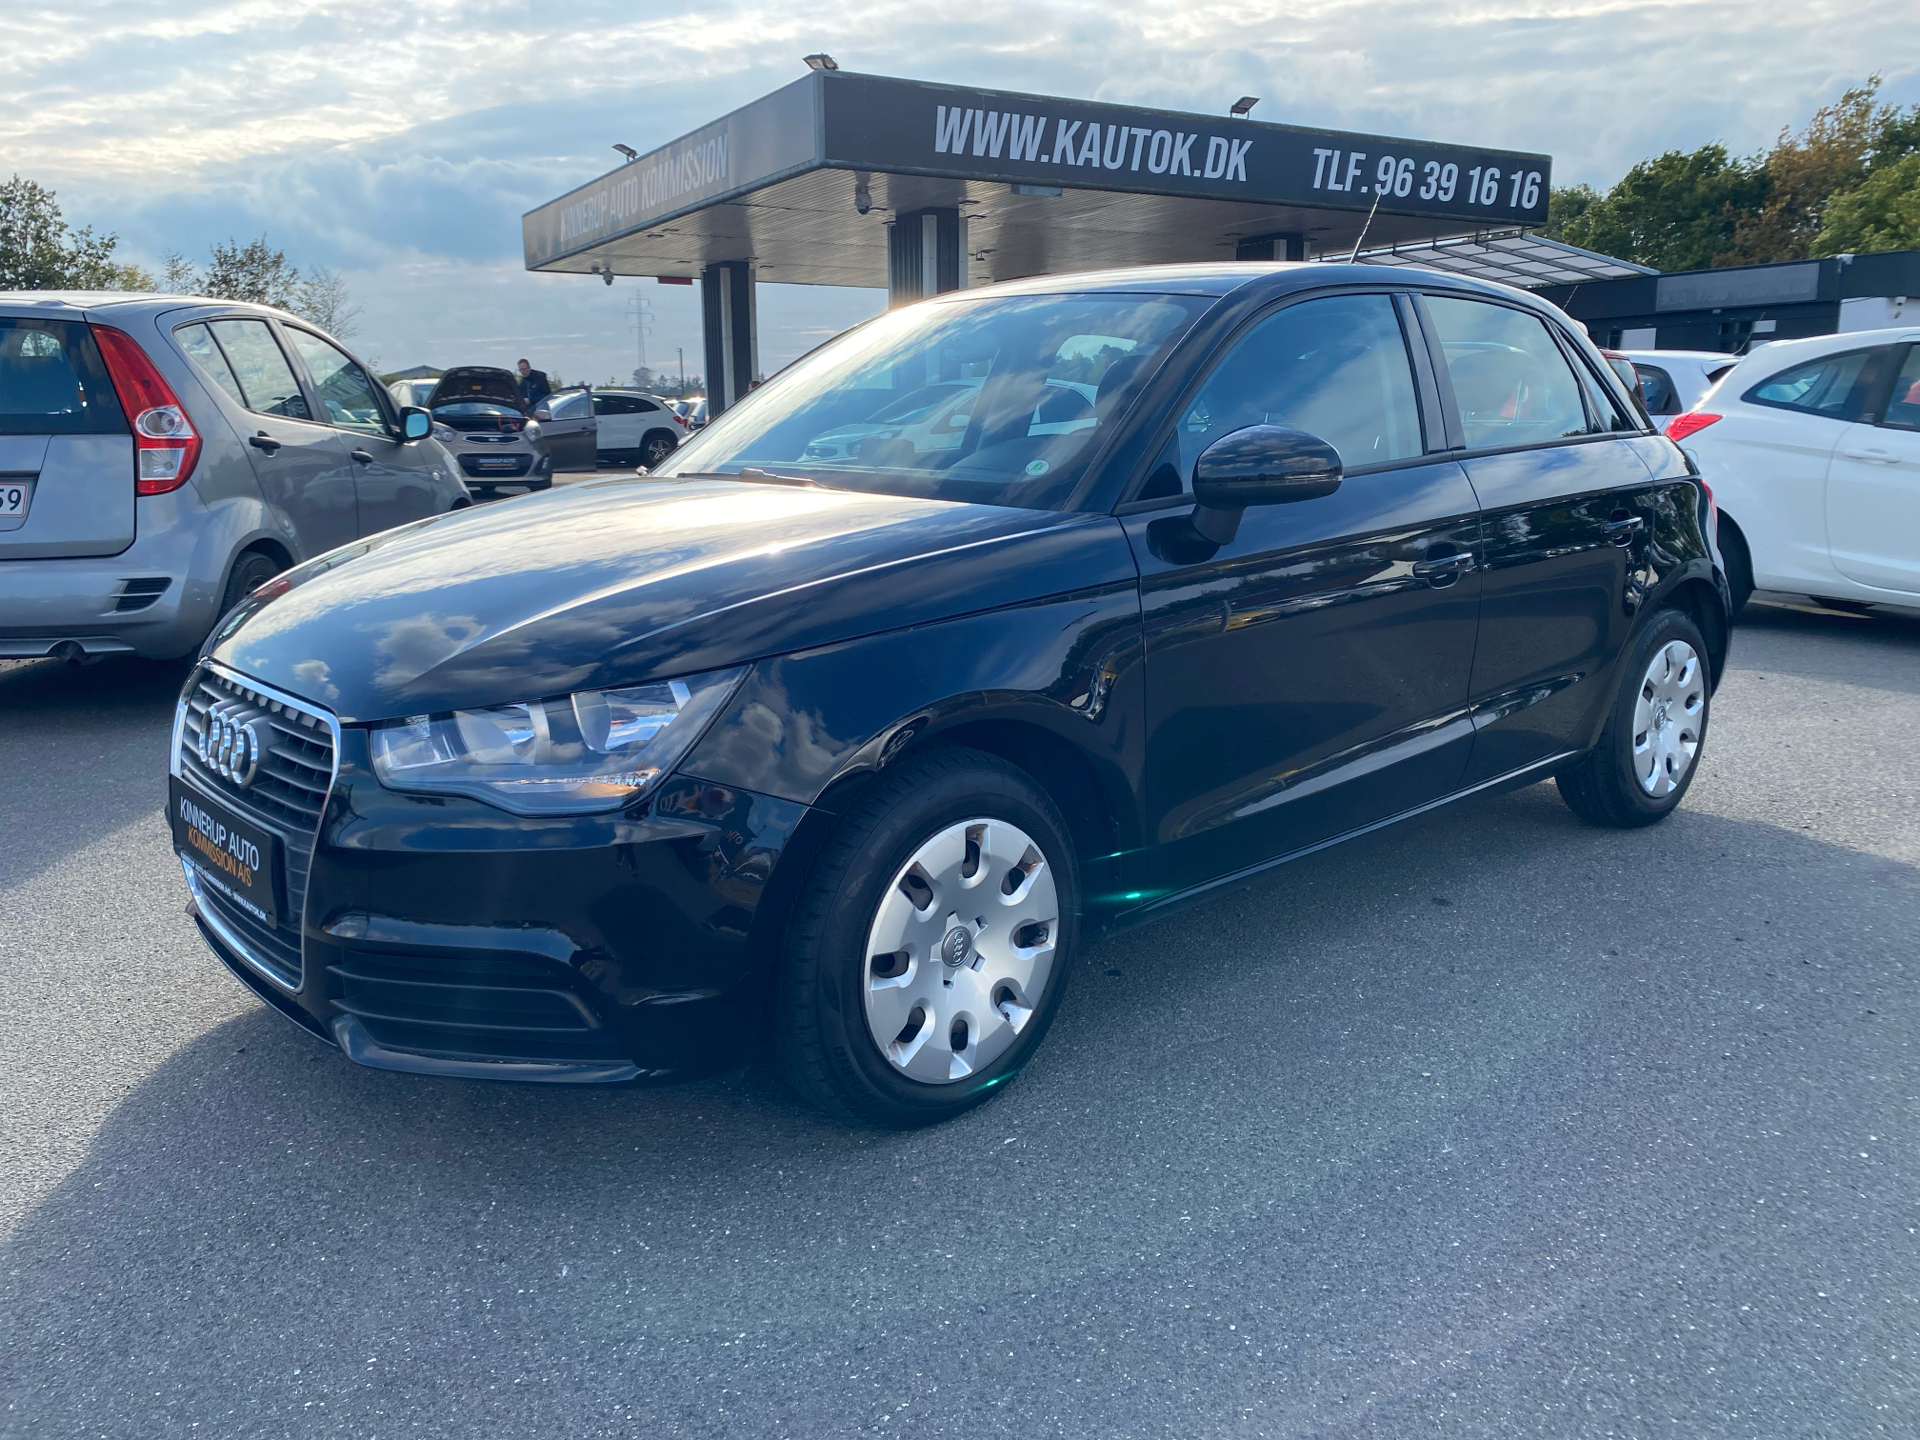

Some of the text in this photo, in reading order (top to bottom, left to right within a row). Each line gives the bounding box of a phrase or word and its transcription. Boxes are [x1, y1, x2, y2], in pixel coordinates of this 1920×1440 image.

[934, 104, 1254, 182] WWW.KAUTOK.DK
[1312, 148, 1542, 210] TLF. 96 39 16 16
[560, 132, 728, 242] KINNERUP AUTO KOMMISSION
[180, 796, 260, 872] KINNERUP AUTO
[188, 825, 237, 877] KOMMISSION
